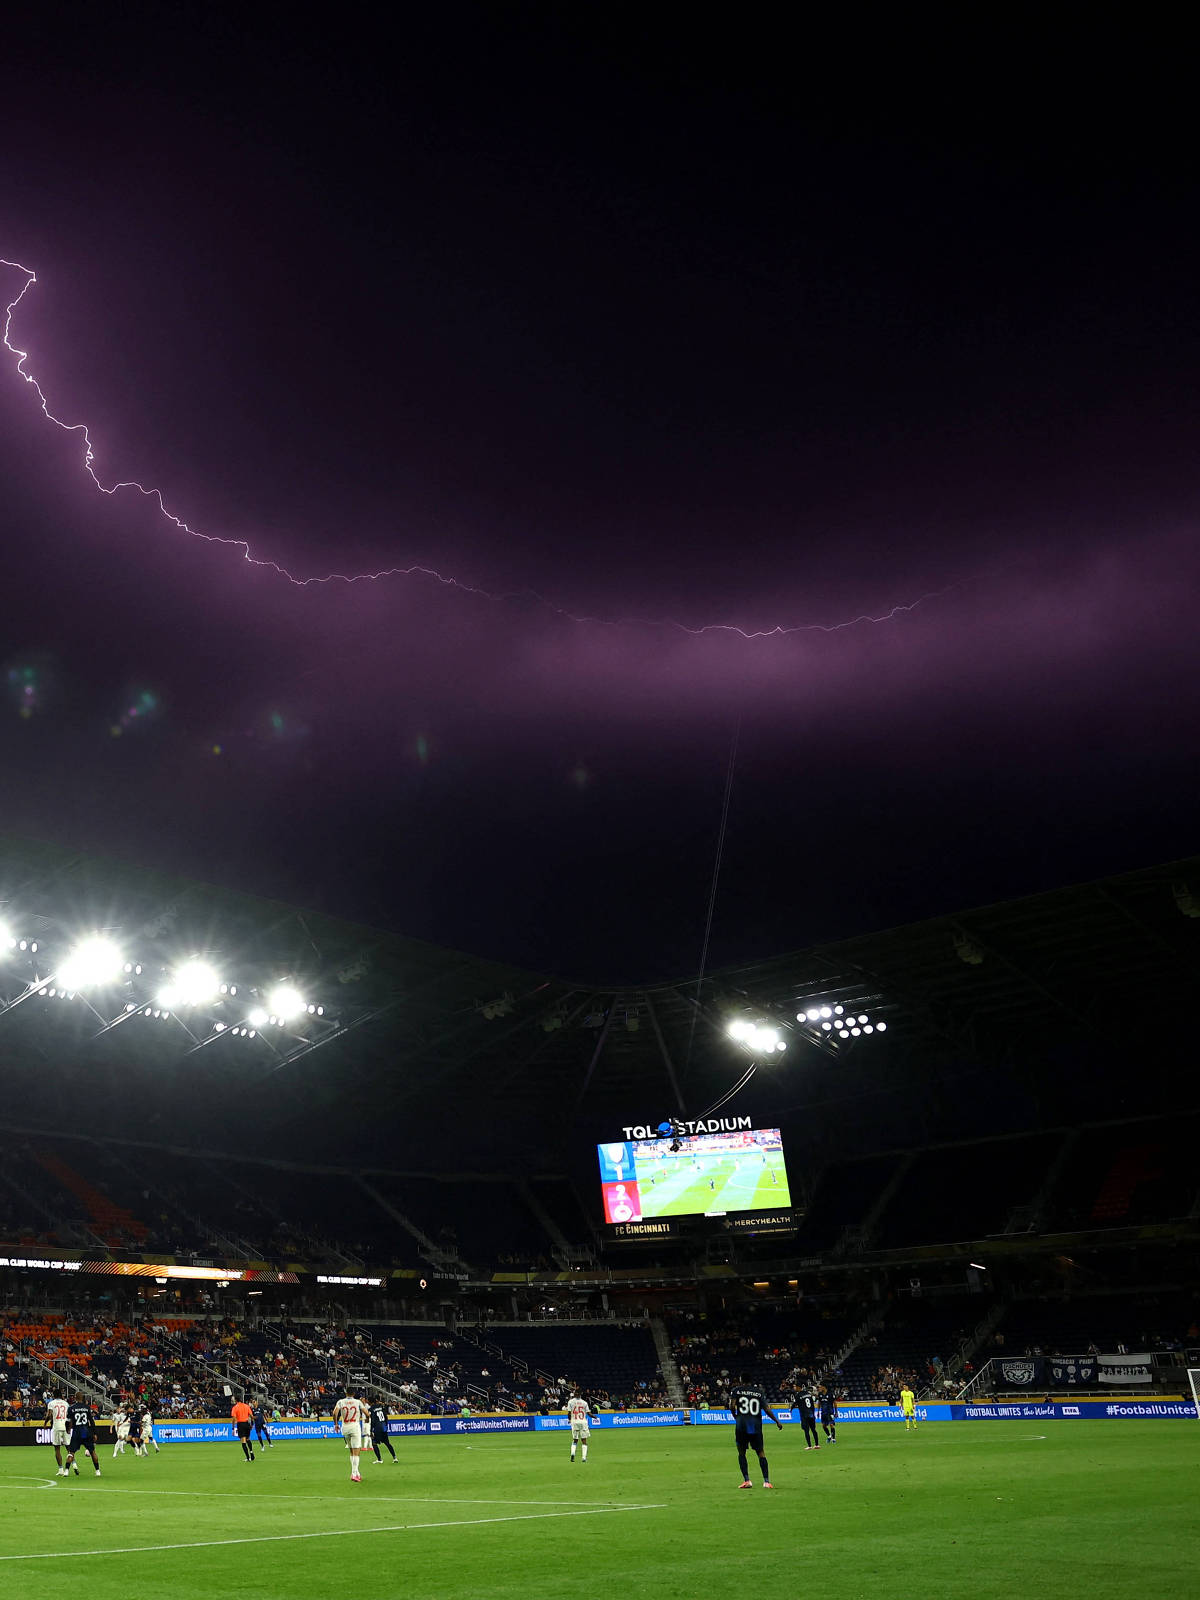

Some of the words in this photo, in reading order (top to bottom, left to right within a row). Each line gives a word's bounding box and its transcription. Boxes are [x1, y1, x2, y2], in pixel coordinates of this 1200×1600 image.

[622, 1126, 657, 1140] TQL
[677, 1116, 752, 1135] STADIUM
[614, 1166, 623, 1181] 1
[615, 1185, 626, 1201] 2
[734, 1216, 791, 1226] MERCYHEALTH
[615, 1226, 625, 1236] FC
[626, 1223, 670, 1235] CINCINNATI
[738, 1396, 760, 1416] 30
[805, 1397, 812, 1408] 8
[342, 1406, 357, 1423] 22
[572, 1406, 585, 1420] 45
[701, 1412, 727, 1421] FOOTBALL
[965, 1407, 997, 1417] FOOTBALL
[998, 1407, 1020, 1416] UNITES
[1022, 1407, 1034, 1416] the
[1034, 1405, 1055, 1416] World
[1106, 1404, 1197, 1416] #FootballUnites
[74, 1413, 88, 1426] 23
[185, 1428, 203, 1438] UNITES
[213, 1427, 229, 1437] World
